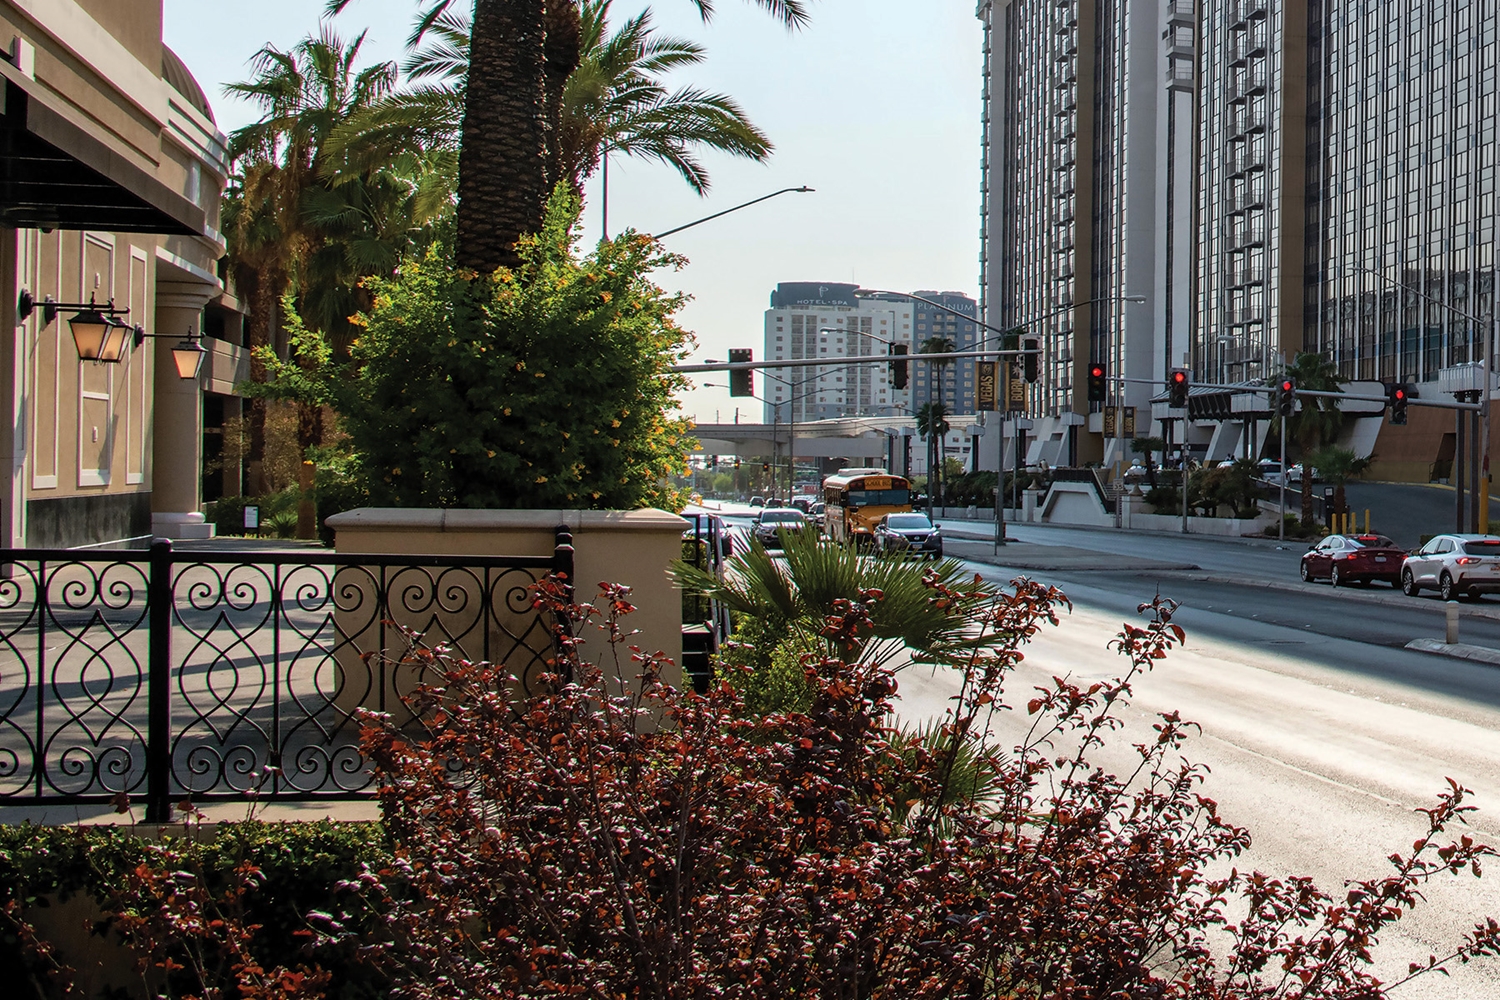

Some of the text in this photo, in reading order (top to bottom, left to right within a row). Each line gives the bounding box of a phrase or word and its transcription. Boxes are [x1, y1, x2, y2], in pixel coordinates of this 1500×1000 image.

[917, 302, 974, 311] PLAINUM
[980, 375, 994, 403] VEGAS
[1010, 378, 1024, 402] BORN
